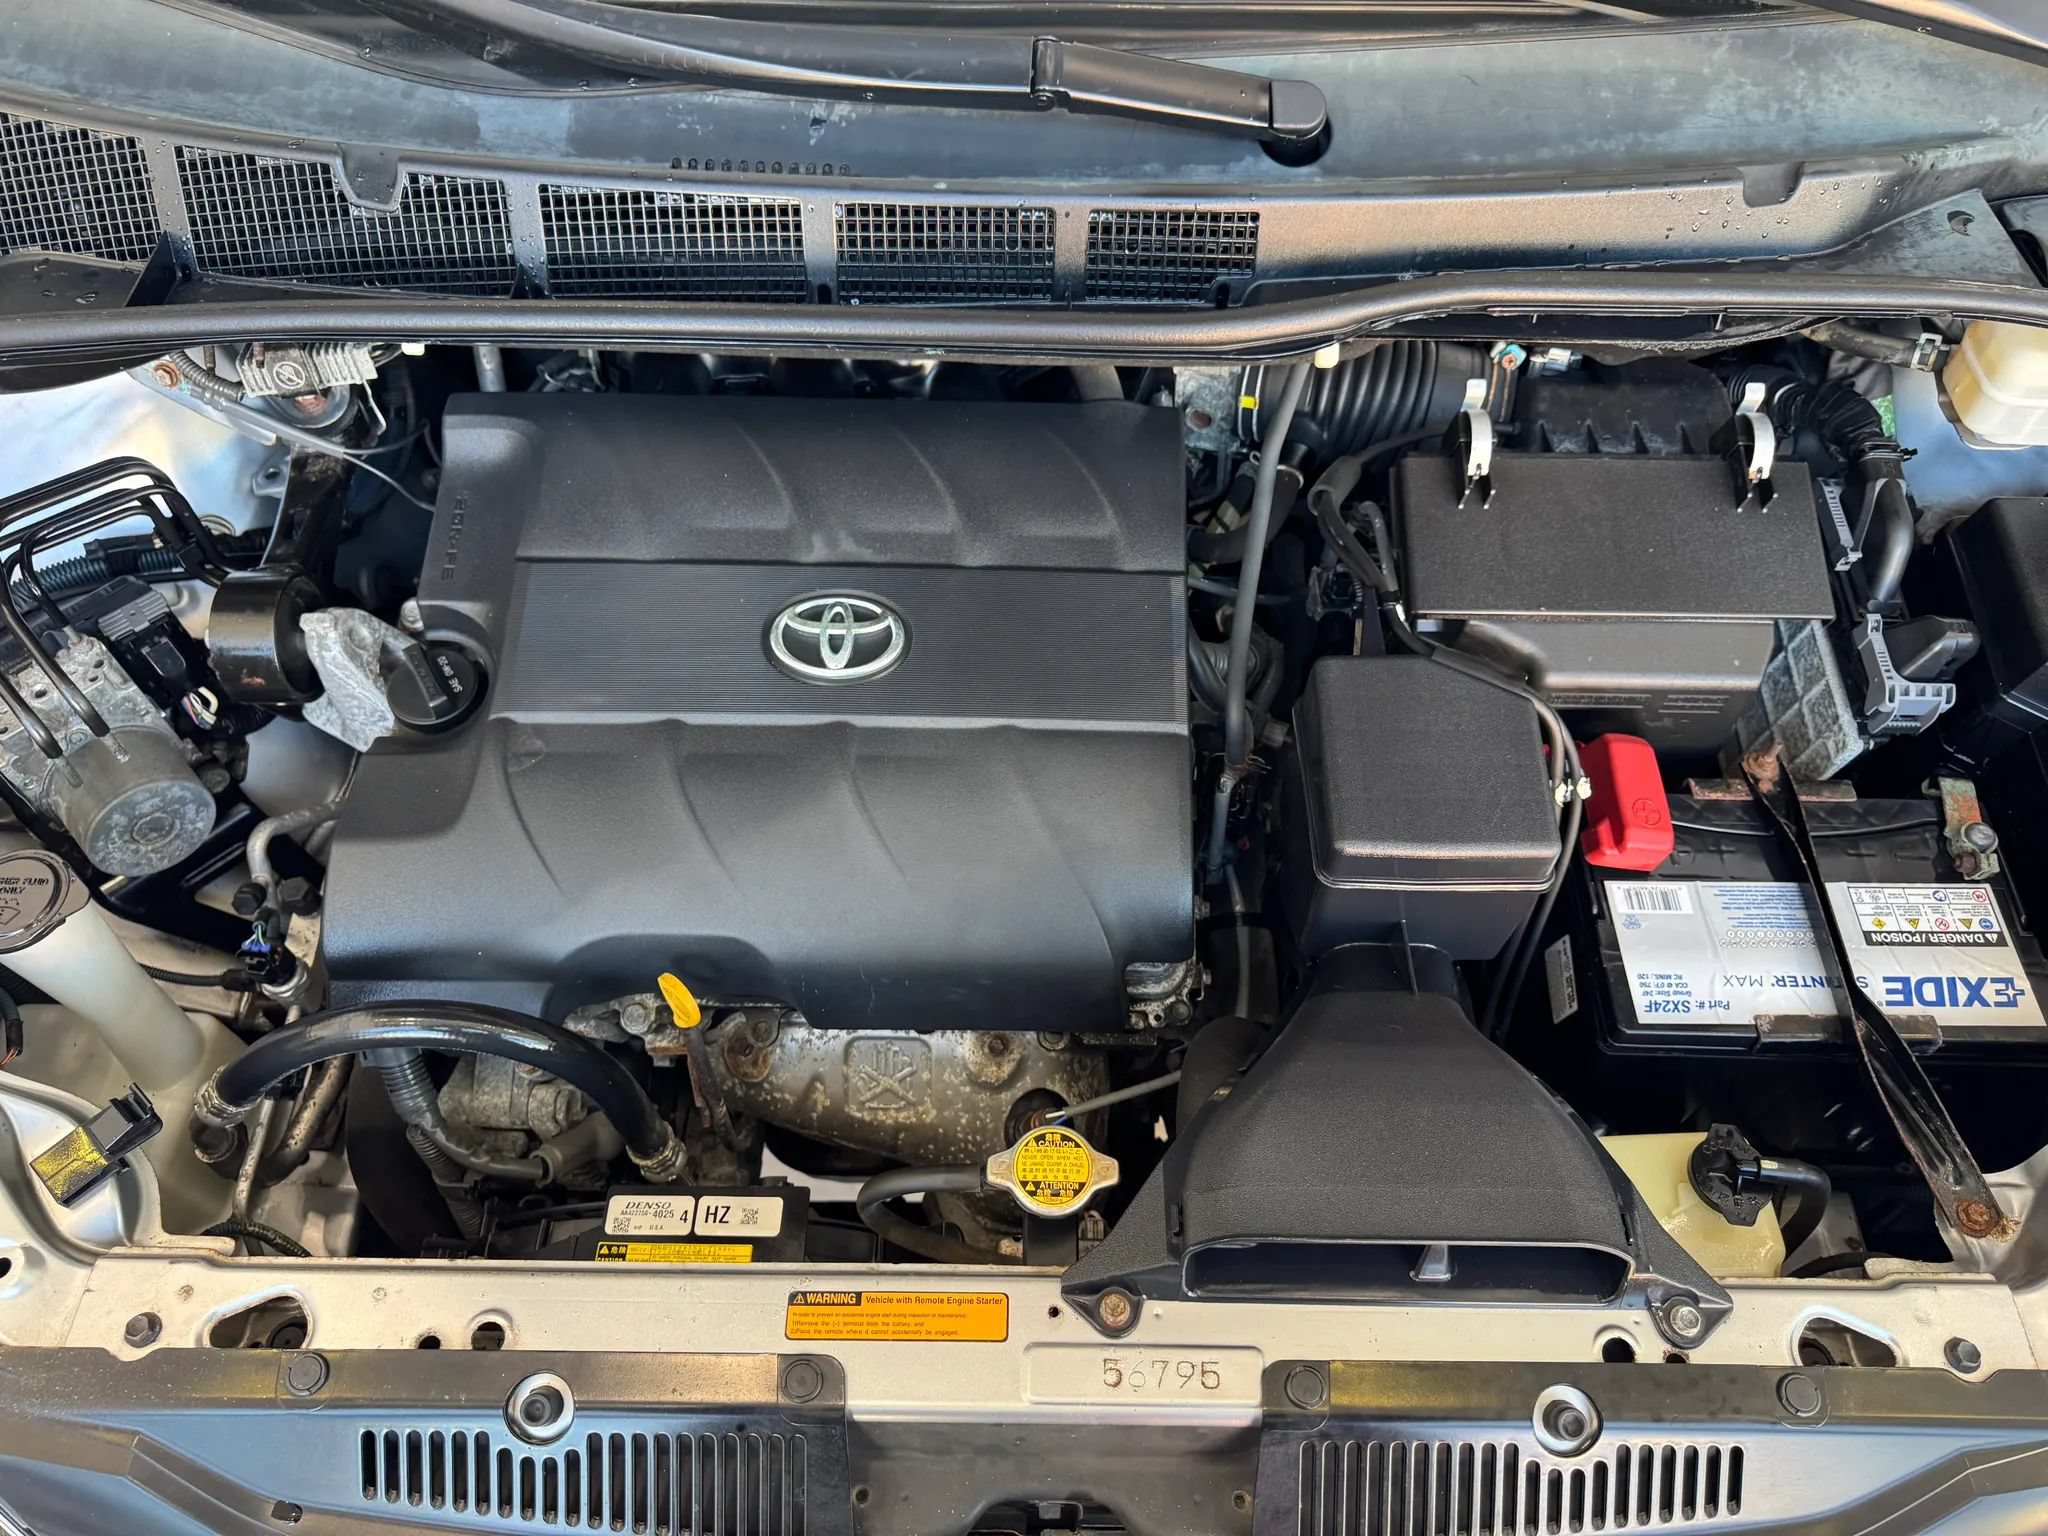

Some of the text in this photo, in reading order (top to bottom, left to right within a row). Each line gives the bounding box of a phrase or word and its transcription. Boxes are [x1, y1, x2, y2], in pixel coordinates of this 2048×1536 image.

[448, 677, 463, 693] SAE
[1929, 933, 1984, 944] DANGER
[1723, 975, 1869, 989] SRINTER MAX
[1882, 976, 2026, 1008] EXIDE
[1644, 1000, 1691, 1013] SX24F
[1709, 1000, 1730, 1010] Part
[1040, 1182, 1079, 1190] ATTENTION
[625, 1201, 672, 1210] DENSO
[679, 1209, 689, 1224] 4
[704, 1205, 731, 1224] HZ
[806, 1292, 1003, 1306] WARNING Vehicle with Remote Engine Starter
[1102, 1358, 1220, 1390] 56795
